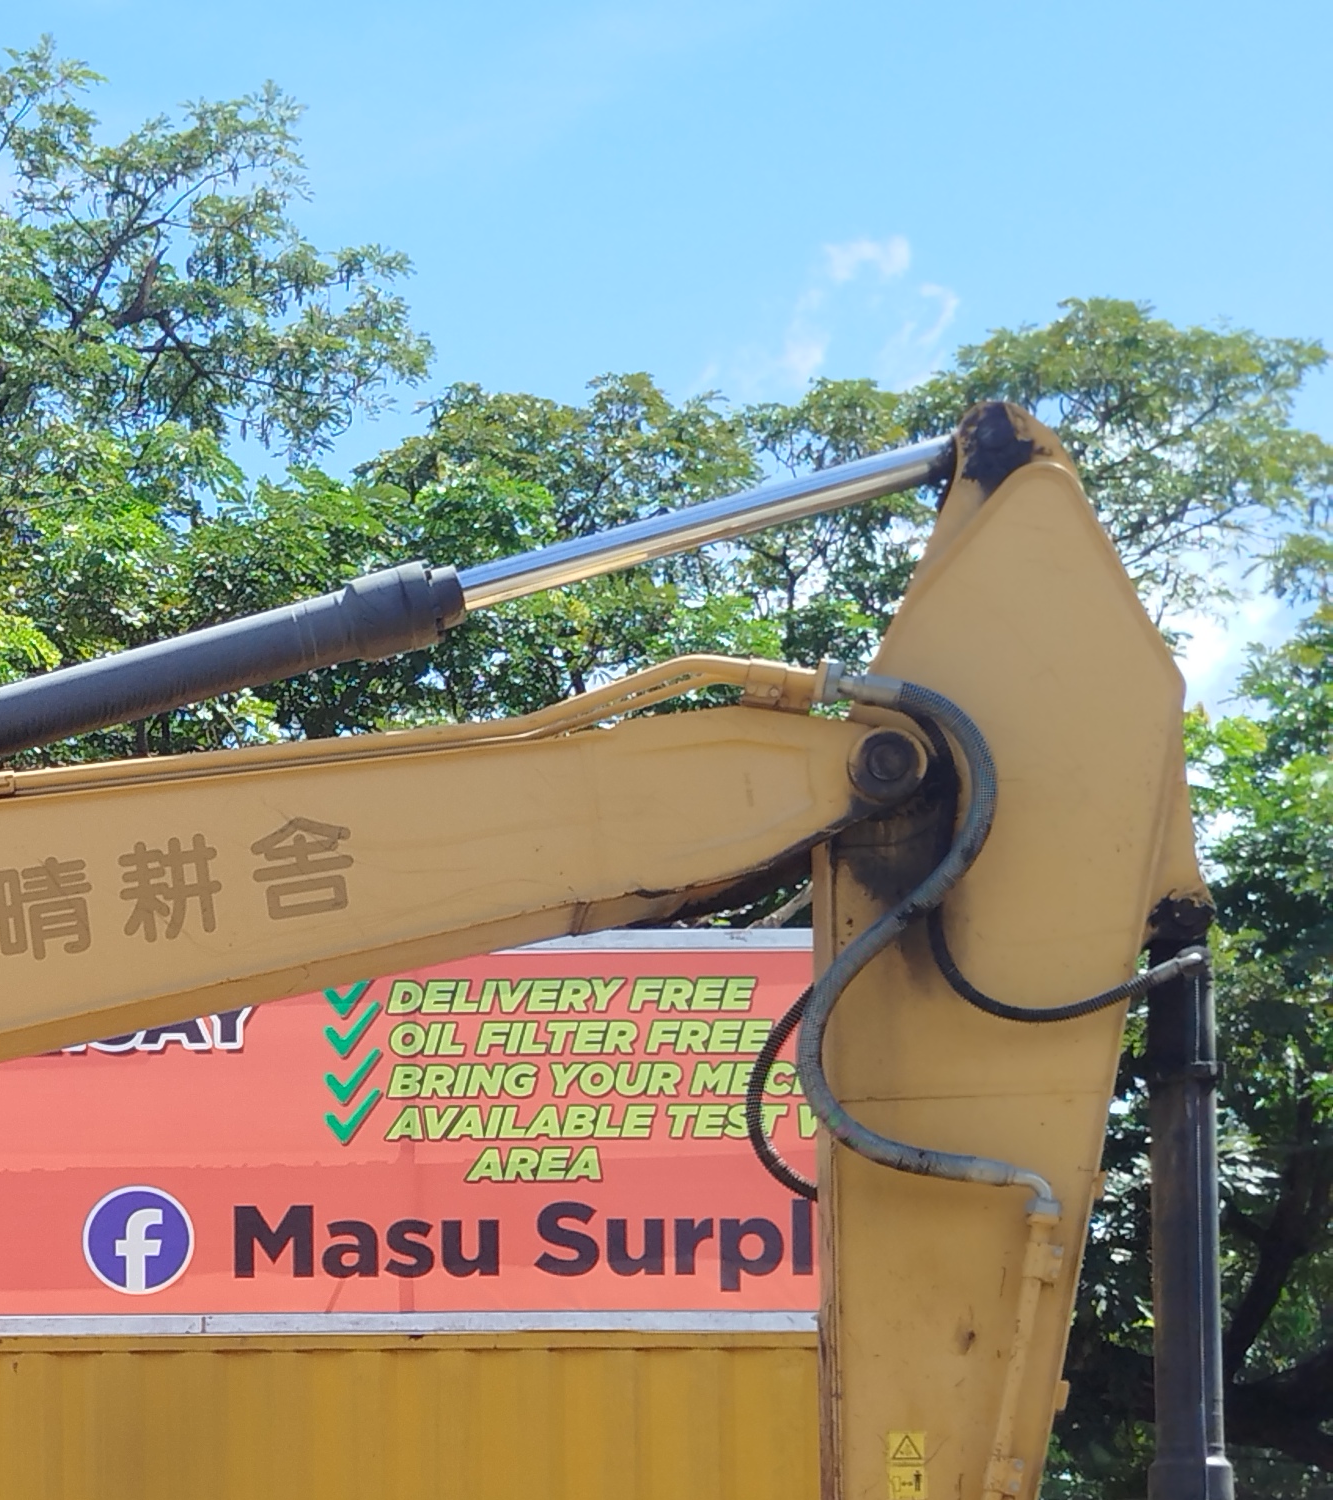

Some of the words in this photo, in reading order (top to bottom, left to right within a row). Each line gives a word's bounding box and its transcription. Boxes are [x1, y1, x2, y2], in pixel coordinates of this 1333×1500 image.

[386, 976, 626, 1014] DELIVERY
[629, 976, 758, 1013] FREE
[389, 1019, 470, 1058] OIL
[474, 1018, 644, 1057] FILTER
[644, 1018, 776, 1054] FREE
[387, 1060, 539, 1100] BRING
[549, 1060, 684, 1099] YOUR
[688, 1059, 806, 1098] MEC
[385, 1103, 654, 1142] AVAILABLE
[667, 1102, 790, 1141] TEST
[464, 1146, 604, 1183] AREA
[232, 1202, 501, 1280] Masu
[533, 1198, 814, 1293] Surpl
